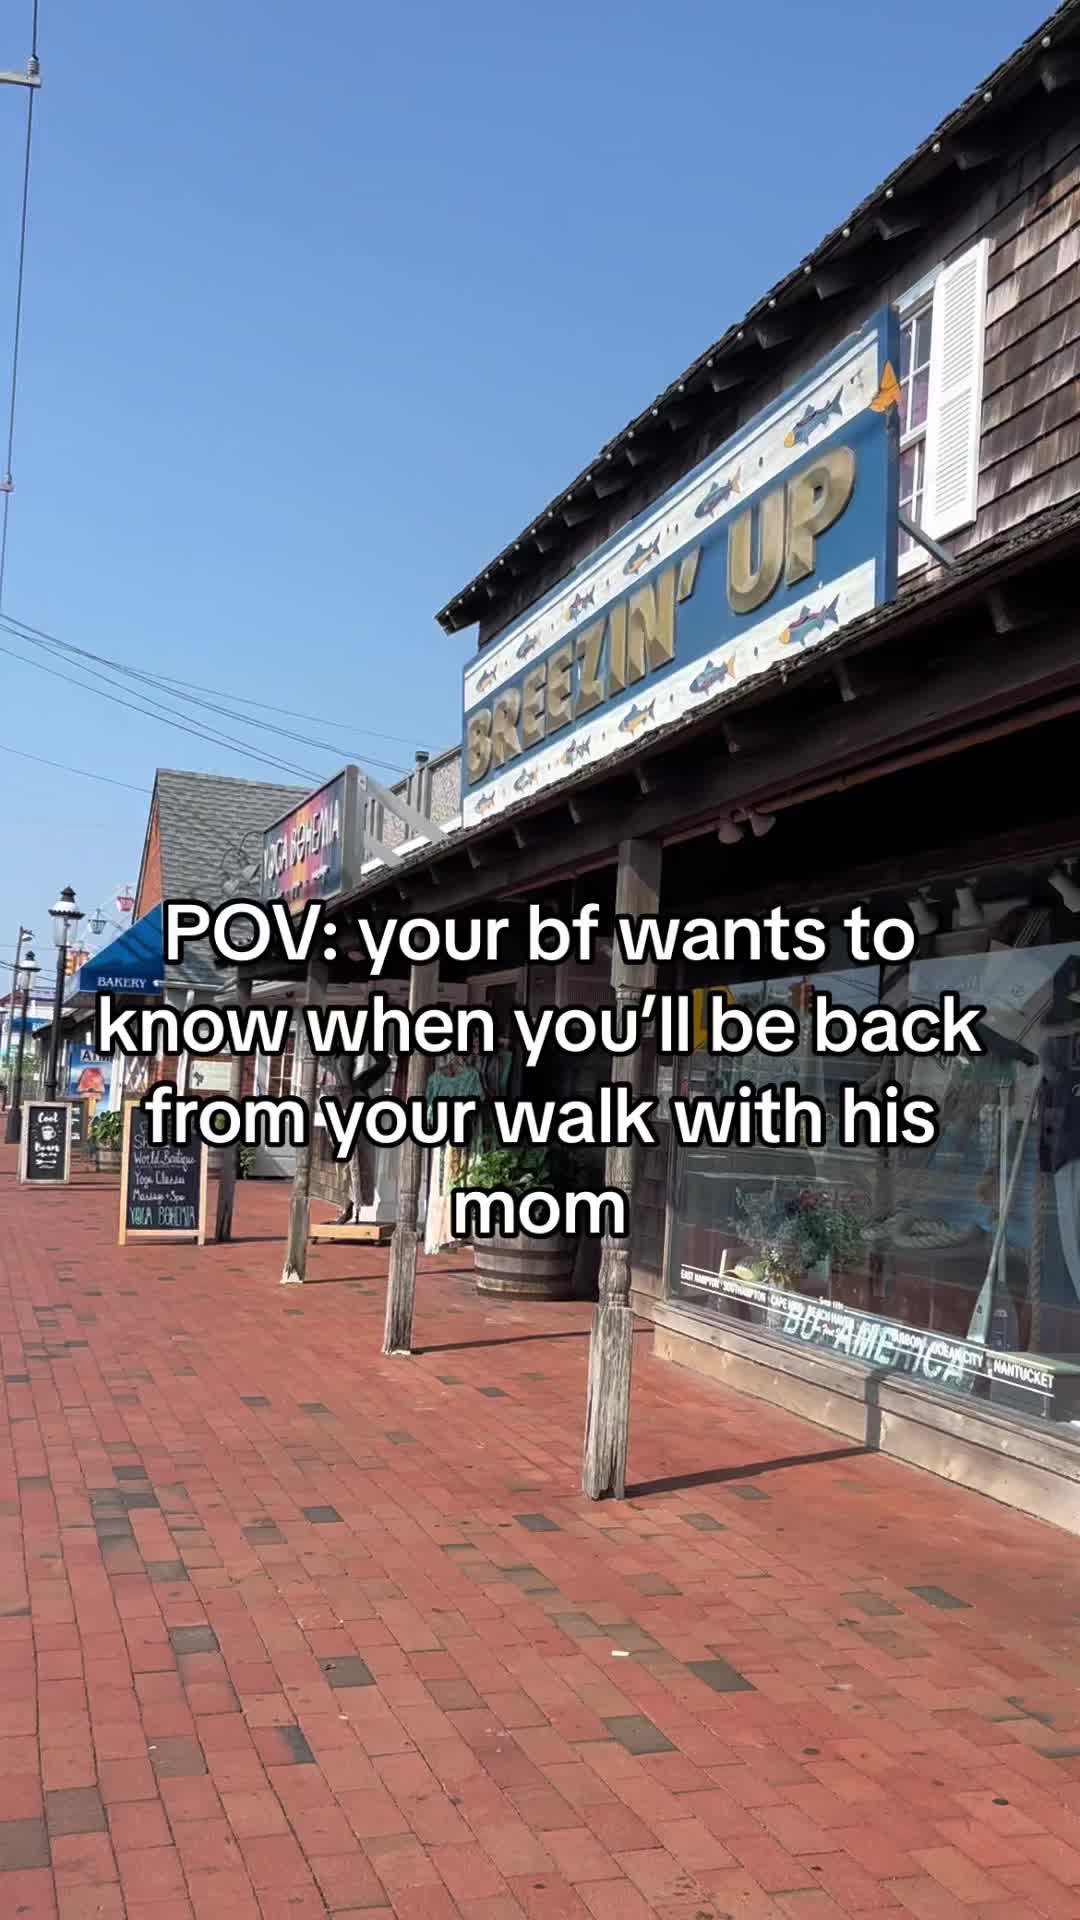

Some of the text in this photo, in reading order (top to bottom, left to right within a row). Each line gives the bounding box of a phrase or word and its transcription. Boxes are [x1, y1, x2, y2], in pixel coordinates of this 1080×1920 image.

[466, 446, 858, 786] BREEZIN' UP
[98, 977, 147, 988] BAKERY
[134, 1150, 161, 1165] World
[134, 1171, 154, 1189] Yoga
[770, 1295, 787, 1310] CAPE
[962, 1350, 984, 1369] CITY
[993, 1358, 1056, 1389] NANTUCKET
